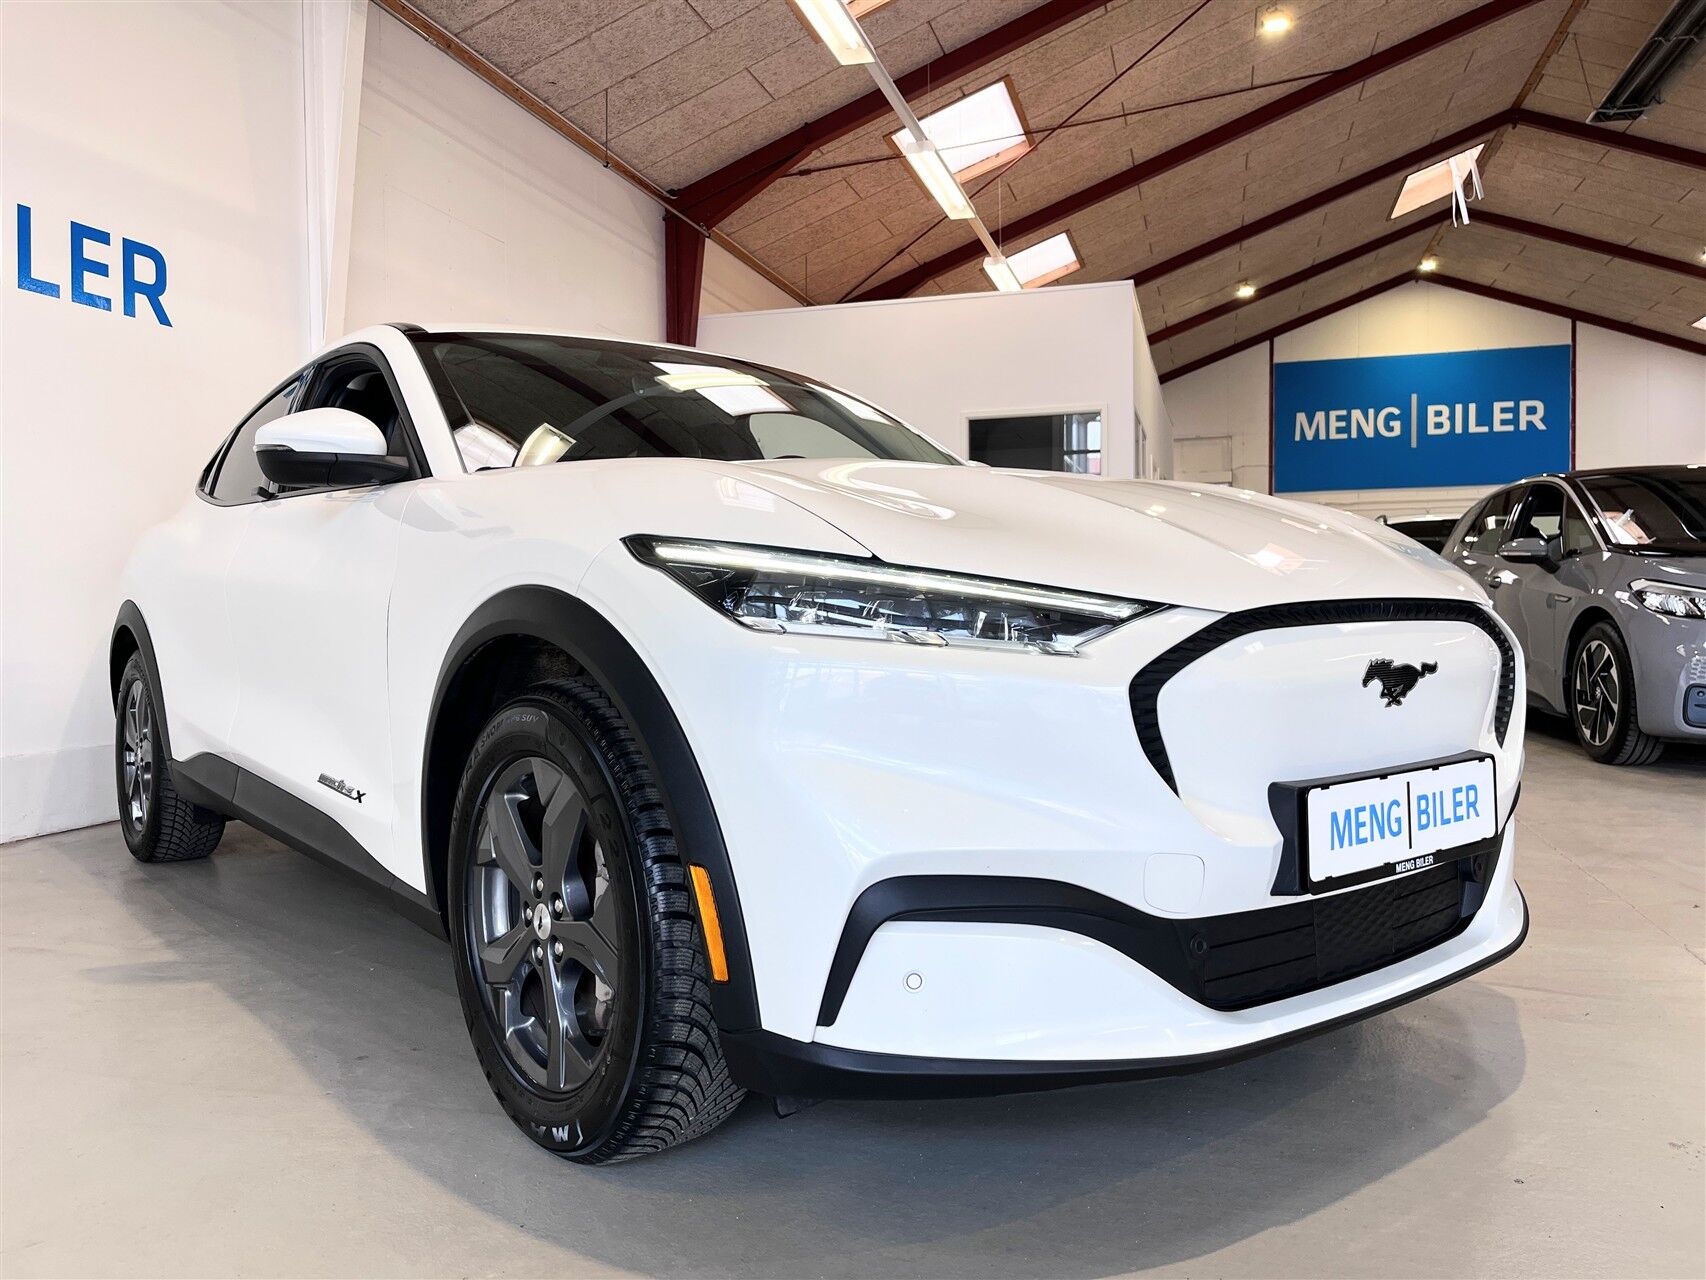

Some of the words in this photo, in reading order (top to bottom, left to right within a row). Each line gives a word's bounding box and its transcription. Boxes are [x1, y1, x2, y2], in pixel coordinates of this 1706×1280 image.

[16, 203, 174, 329] LER
[1294, 406, 1401, 441] MENG
[1427, 400, 1548, 435] BILER
[1330, 799, 1402, 851] MENG
[1416, 784, 1480, 831] BILER
[1395, 860, 1415, 874] MENG
[1415, 855, 1434, 869] BILER
